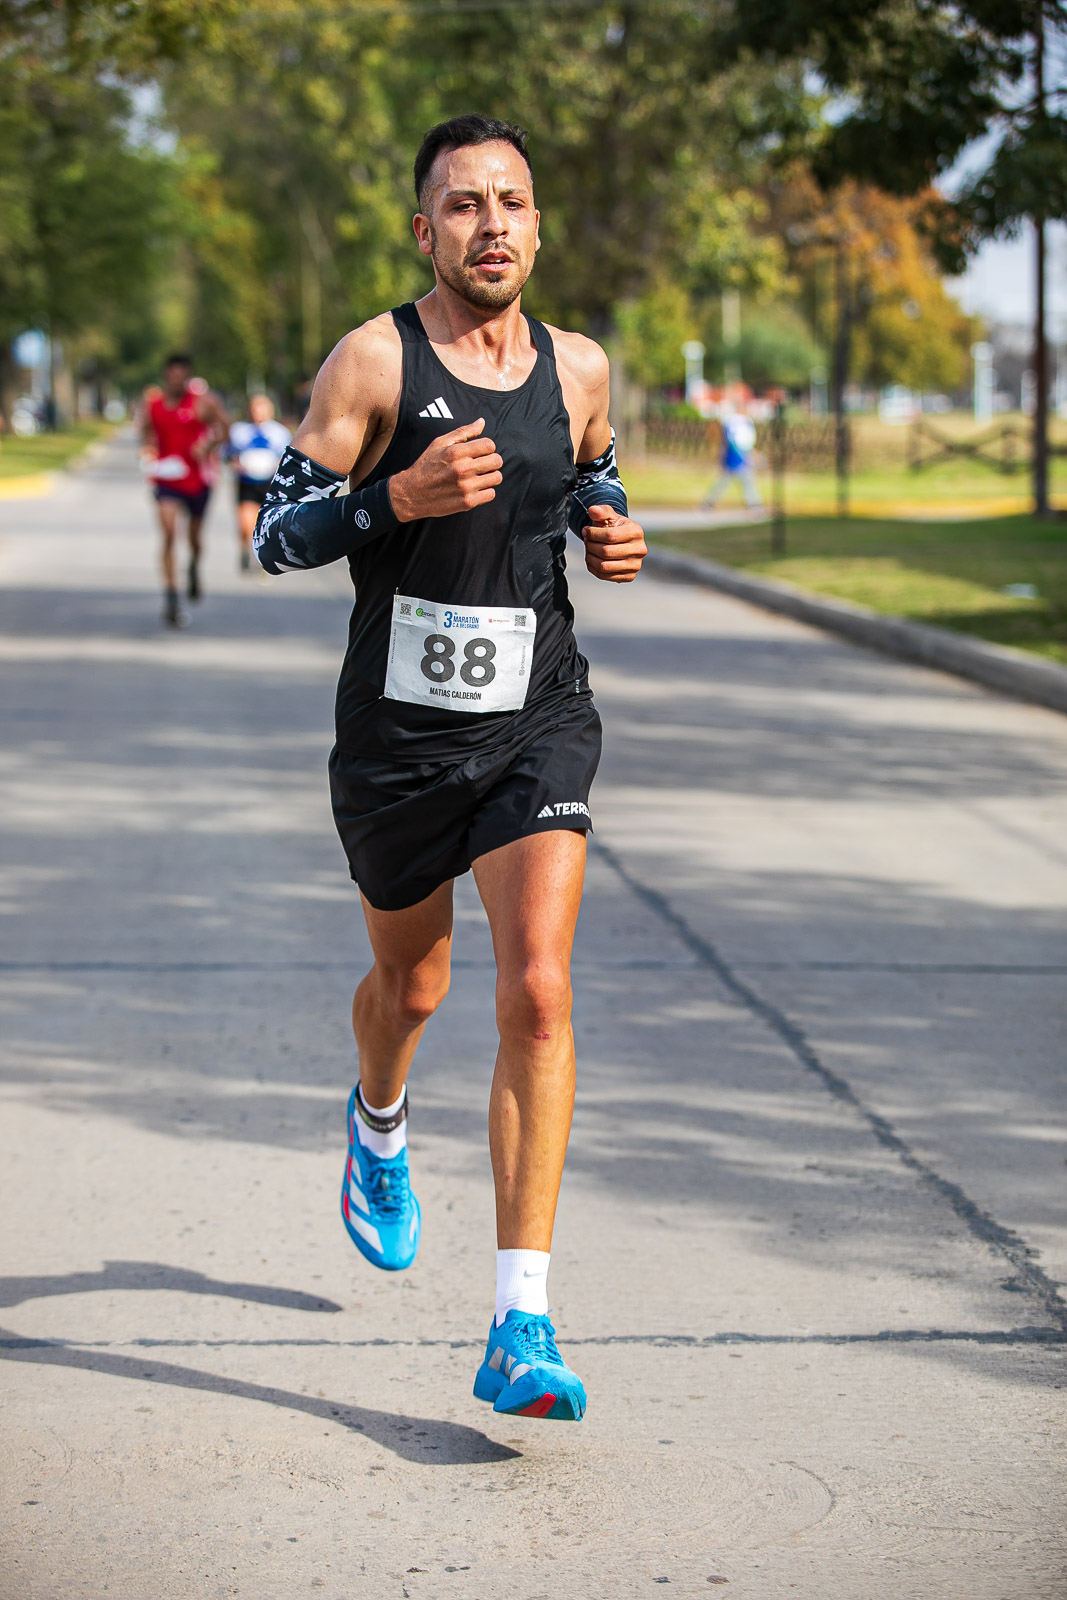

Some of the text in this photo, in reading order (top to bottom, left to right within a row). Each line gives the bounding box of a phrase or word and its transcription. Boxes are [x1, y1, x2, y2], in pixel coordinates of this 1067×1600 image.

[421, 634, 496, 687] 88
[429, 687, 481, 700] MATIAS CALDERÓN
